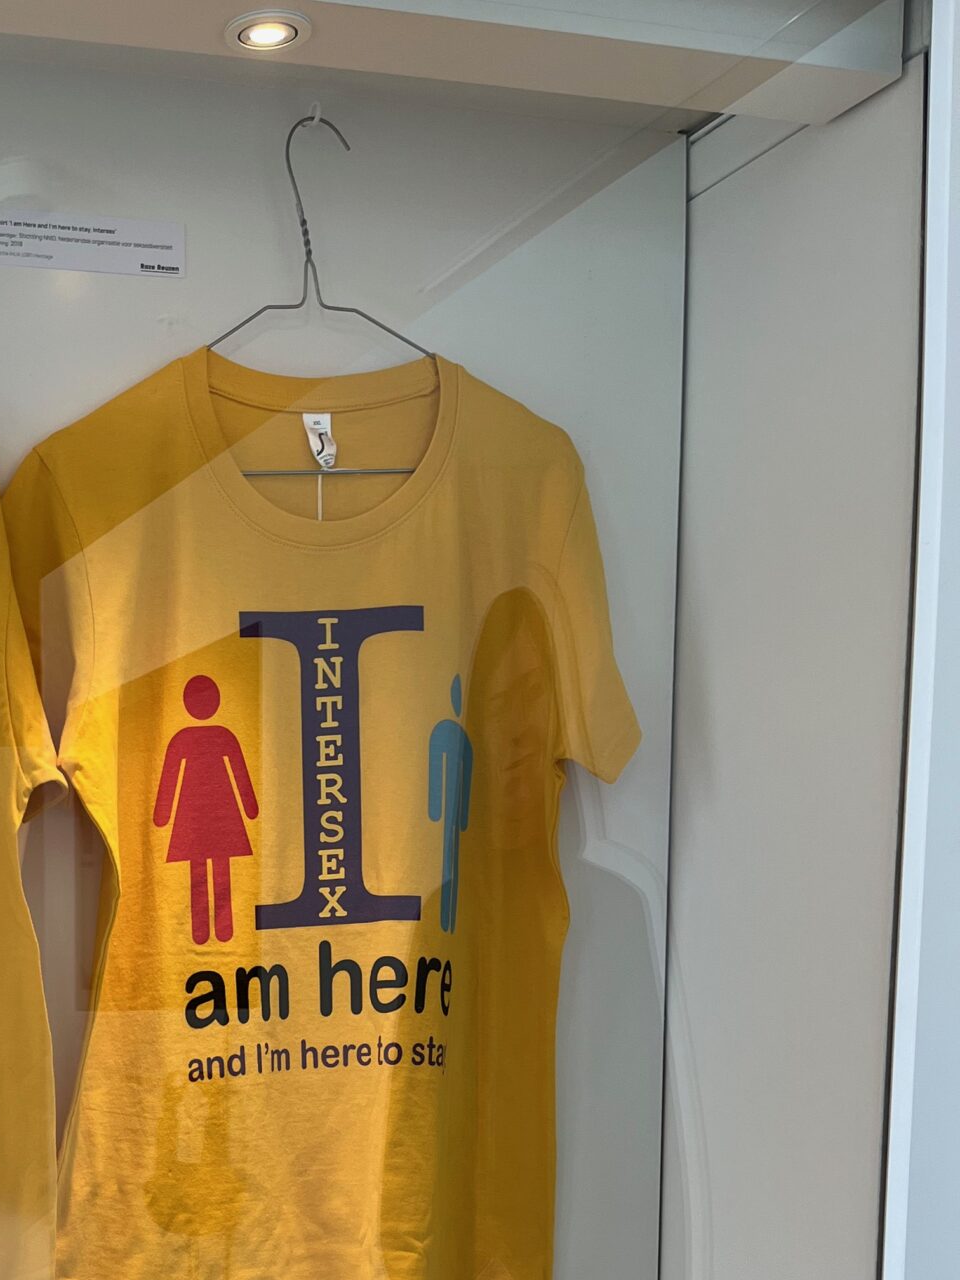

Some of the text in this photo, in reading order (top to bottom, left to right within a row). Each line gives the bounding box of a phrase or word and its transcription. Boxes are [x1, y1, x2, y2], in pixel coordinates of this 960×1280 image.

[238, 605, 424, 930] I
[313, 617, 348, 918] INTERSEX
[184, 939, 453, 1030] am here
[188, 1035, 447, 1083] and I'm here to sta
